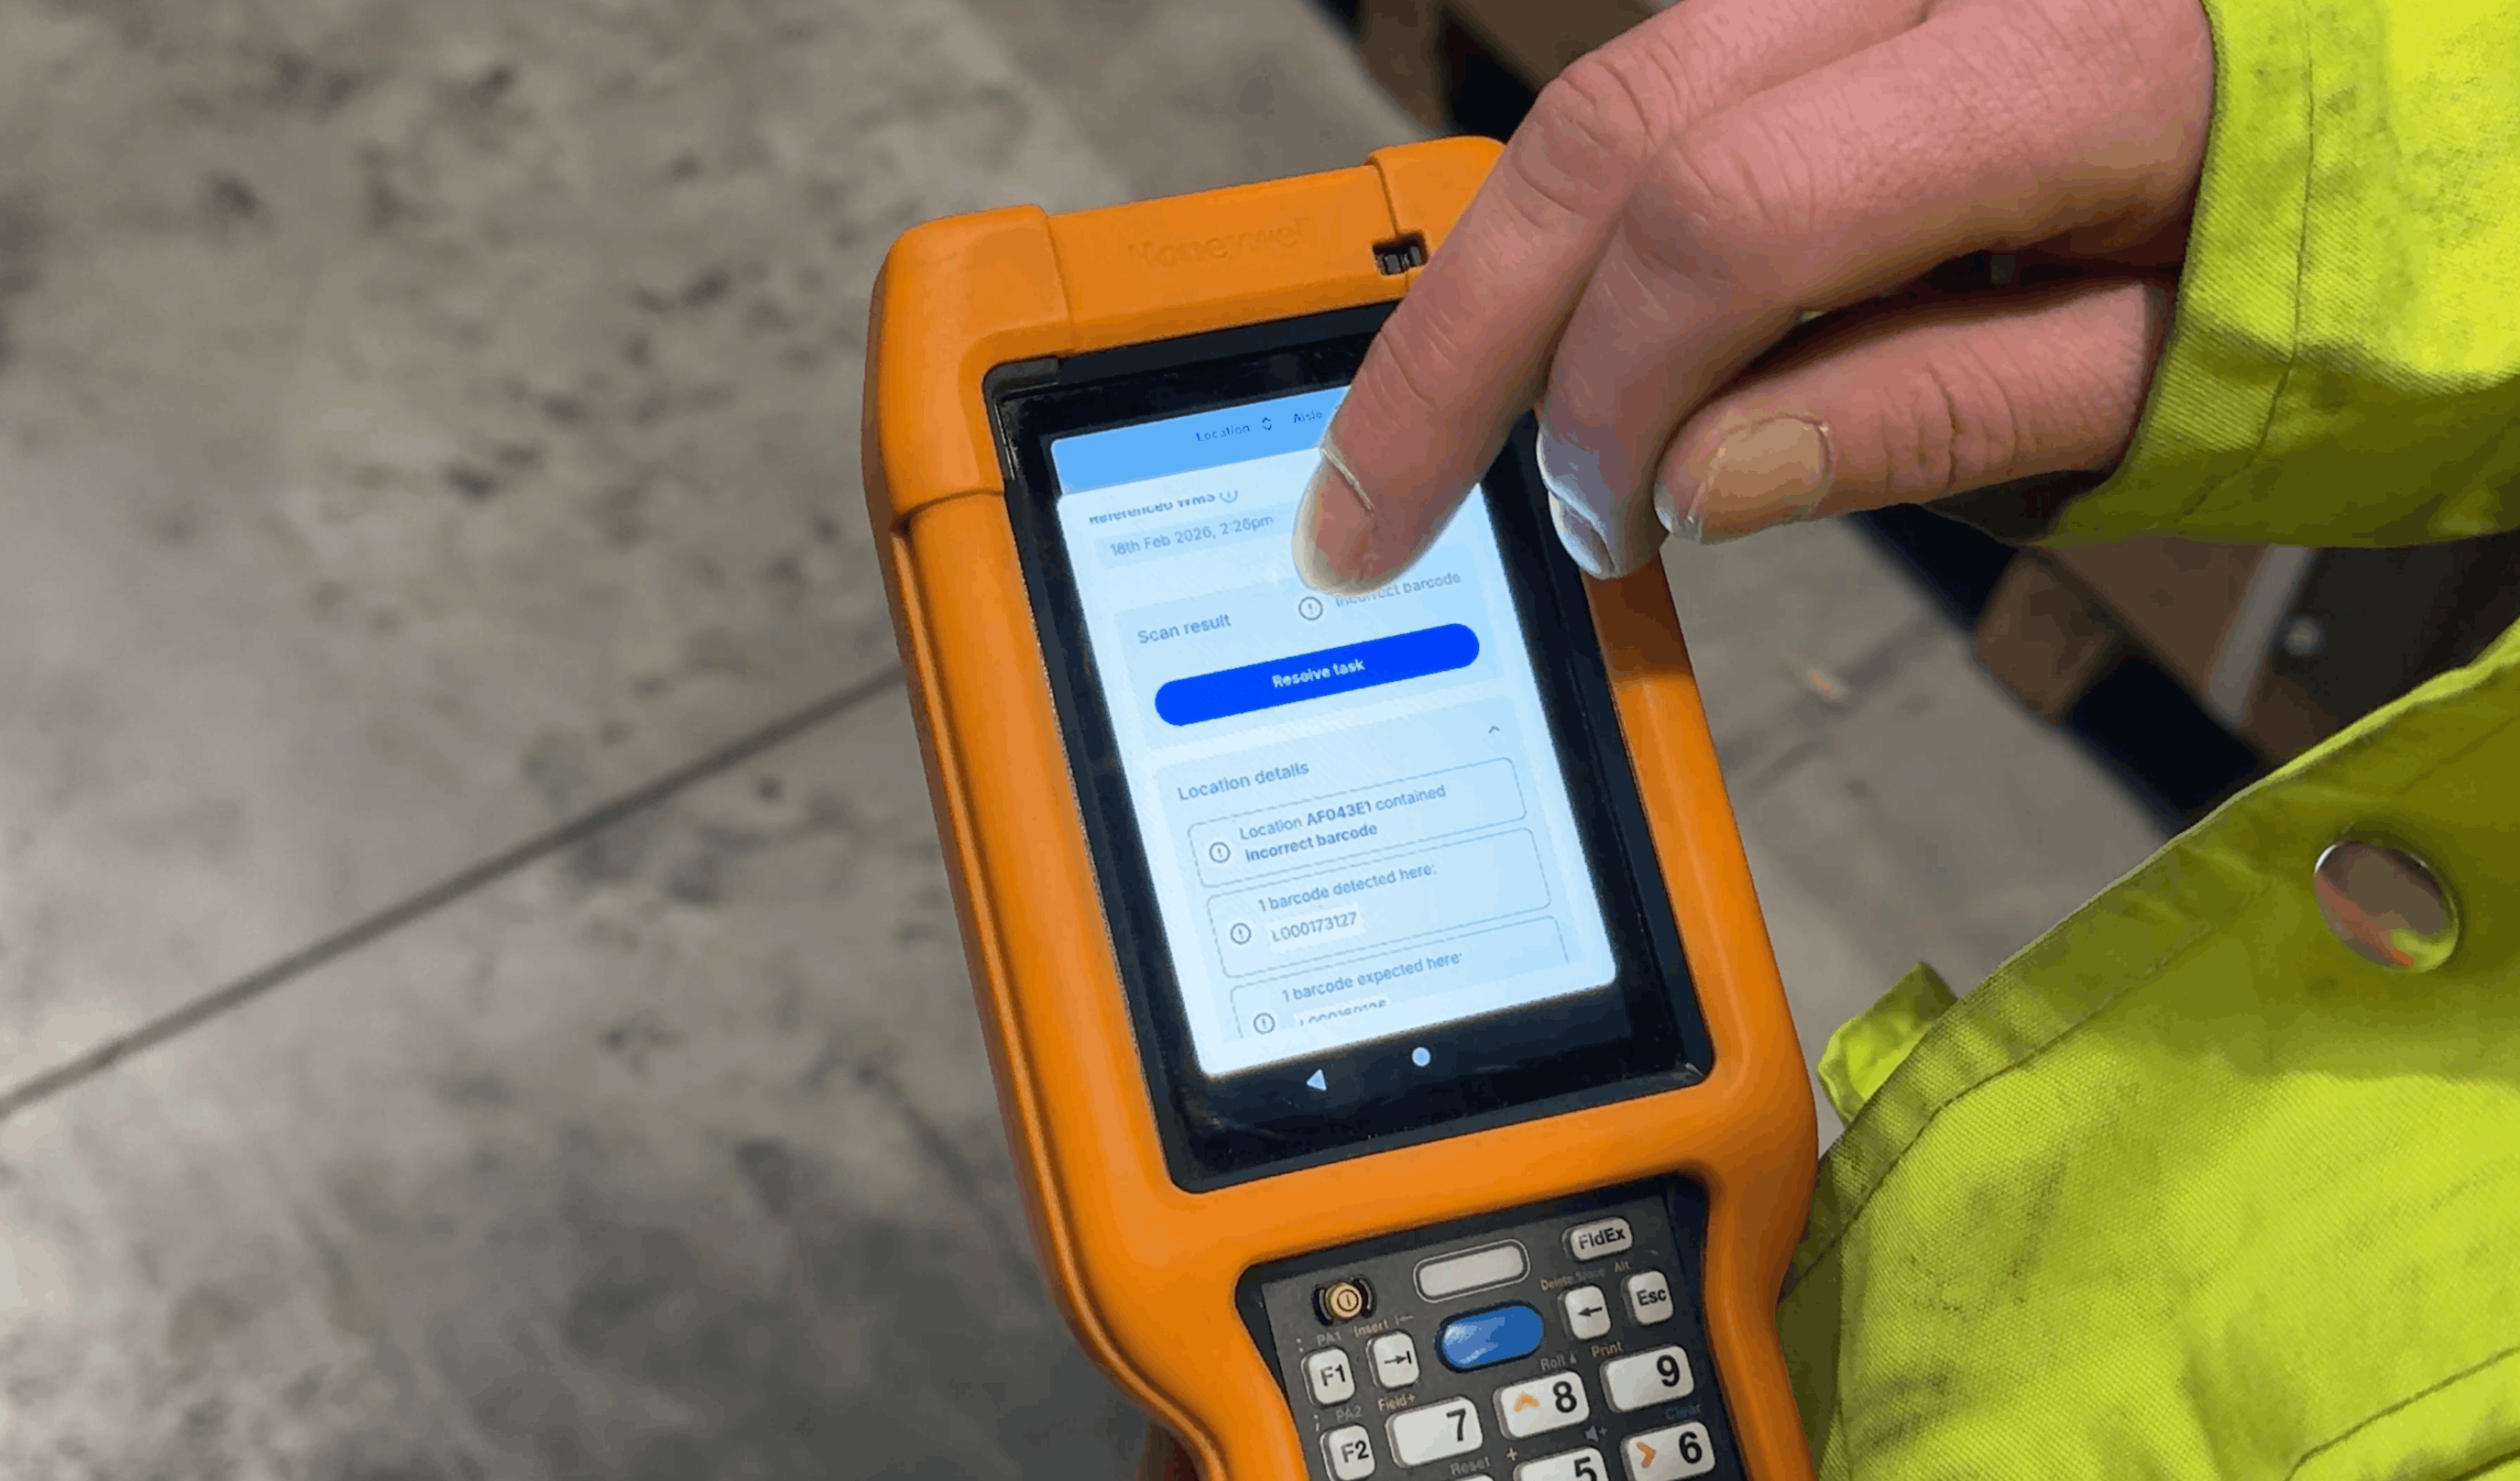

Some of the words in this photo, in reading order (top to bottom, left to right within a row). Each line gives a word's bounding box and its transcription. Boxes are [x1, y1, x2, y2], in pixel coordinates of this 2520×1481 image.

[1196, 424, 1250, 442] Location
[1144, 534, 1171, 550] Feb
[1403, 572, 1463, 594] barcode
[1137, 620, 1180, 644] Scan
[1183, 613, 1233, 637] result
[1272, 666, 1331, 688] Resolve
[1332, 659, 1365, 676] task
[1178, 774, 1251, 801] Location
[1255, 762, 1309, 784] details
[1239, 817, 1303, 840] Location
[1306, 801, 1374, 827] AF043E1
[1375, 785, 1447, 812] contained
[1244, 836, 1313, 862] Incorrect
[1315, 822, 1378, 847] barcode
[1257, 897, 1267, 913] 1
[1269, 885, 1330, 910] barcode
[1332, 872, 1397, 896] detected
[1271, 911, 1358, 942] L000173127
[1282, 989, 1290, 1004] 1
[1292, 977, 1353, 1001] barcode
[1357, 959, 1424, 985] expected
[1578, 1227, 1627, 1250] FldEx
[1637, 1289, 1667, 1306] Esc
[1316, 1331, 1342, 1345] PA1
[1353, 1320, 1389, 1337] Insert
[1591, 1340, 1624, 1358] Print
[1320, 1364, 1346, 1387] F1
[1656, 1355, 1681, 1388] 9
[1552, 1381, 1577, 1413] 8
[1335, 1405, 1362, 1422] PA2
[1446, 1408, 1467, 1443] 7
[1341, 1440, 1369, 1464] F2
[1679, 1431, 1703, 1465] 6
[1450, 1455, 1491, 1476] Reset
[1573, 1456, 1598, 1481] 5
